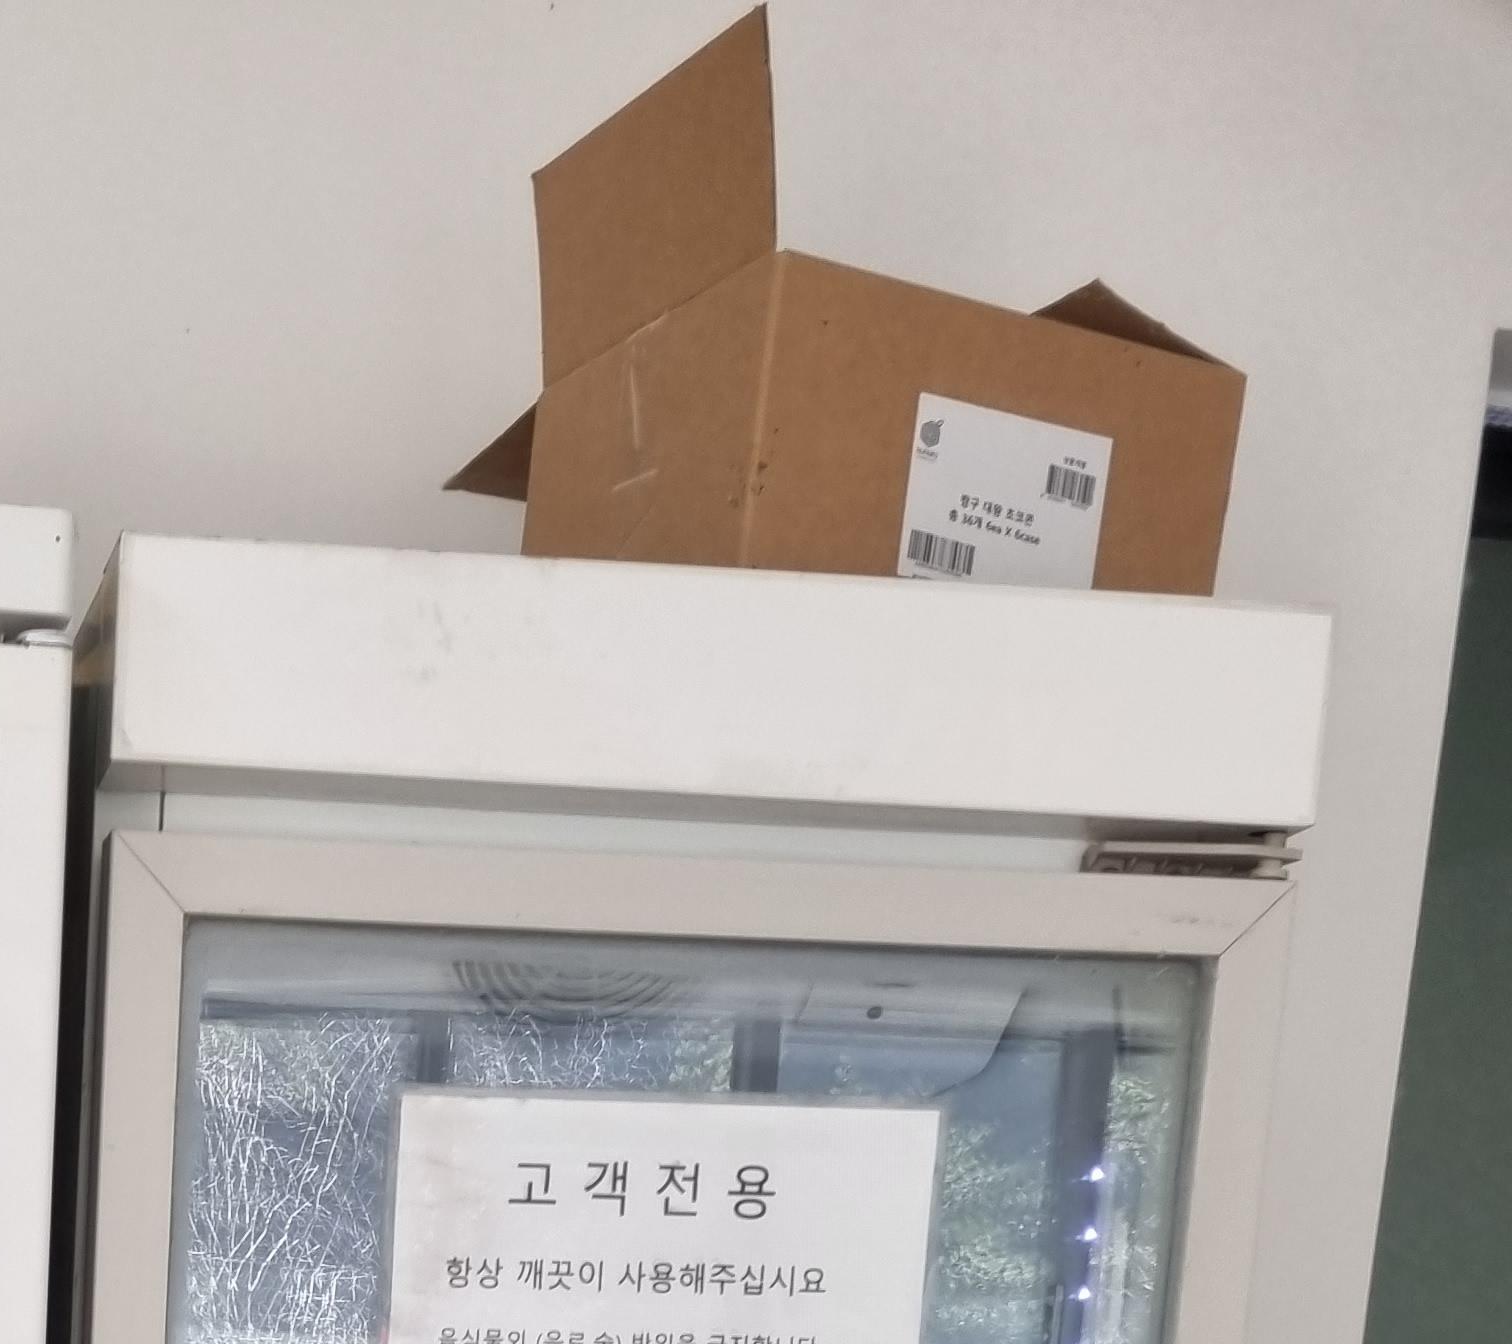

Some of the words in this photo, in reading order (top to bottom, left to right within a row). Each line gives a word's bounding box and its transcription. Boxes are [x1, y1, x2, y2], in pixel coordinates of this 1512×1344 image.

[445, 1256, 504, 1291] 항상
[516, 1257, 605, 1293] 깨끗이
[618, 1260, 828, 1298] 사용해주십시요
